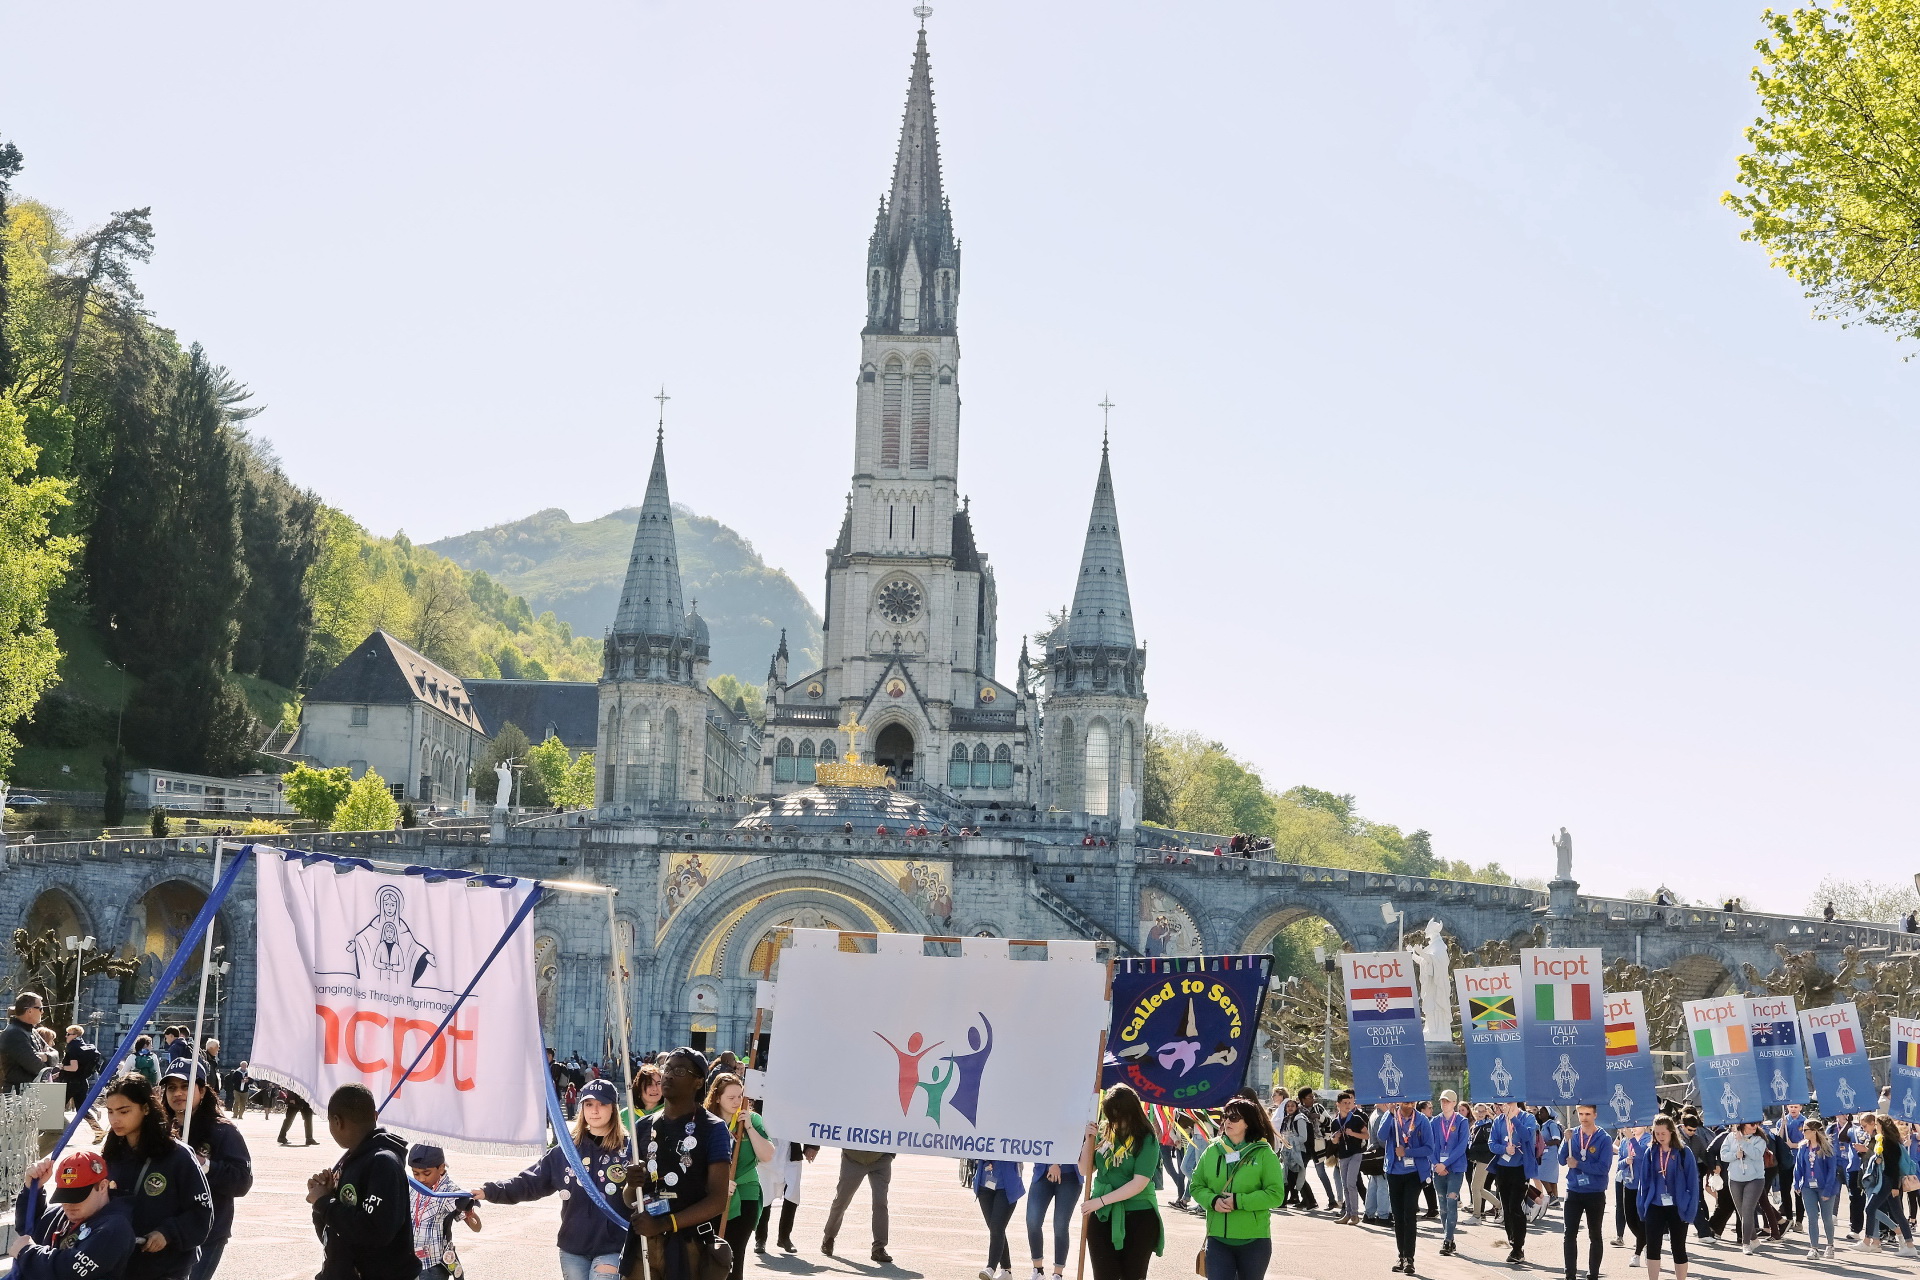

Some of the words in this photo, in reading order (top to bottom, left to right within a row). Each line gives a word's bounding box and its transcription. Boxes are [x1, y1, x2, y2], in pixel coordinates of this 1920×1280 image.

[1352, 958, 1404, 983] hcpt
[1533, 954, 1590, 980] hcpt
[1464, 972, 1512, 995] hcpt
[369, 989, 405, 1006] Through
[1121, 982, 1176, 1042] Called
[1180, 978, 1205, 995] to
[1207, 984, 1243, 1039] Serve
[1603, 998, 1633, 1021] cpt
[1693, 1001, 1737, 1023] hcpt
[1752, 1001, 1788, 1019] hcpt
[1807, 1008, 1850, 1028] hcpt
[1366, 1025, 1406, 1037] CROATIA
[1472, 1033, 1493, 1043] WEST
[1494, 1032, 1521, 1042] INDIES
[1550, 1025, 1579, 1036] ITALIA
[1897, 1021, 1920, 1041] hcp
[1372, 1036, 1402, 1046] D.U.H.
[1552, 1035, 1577, 1046] C.P.T.
[1759, 1049, 1794, 1058] AUSTRALIA
[170, 1061, 185, 1070] 610
[1606, 1058, 1634, 1070] SPAÑA
[1709, 1058, 1740, 1069] IRELAND
[1824, 1057, 1853, 1068] FRANCE
[589, 1083, 603, 1091] 610
[1127, 1064, 1166, 1098] HCPT
[1173, 1079, 1211, 1099] CSG
[809, 1122, 842, 1141] THE
[846, 1126, 892, 1146] IRISH
[896, 1130, 996, 1153] PILGRIMAGE
[1000, 1138, 1054, 1156] TRUST
[72, 1261, 88, 1277] 610
[74, 1250, 99, 1273] HCPT
